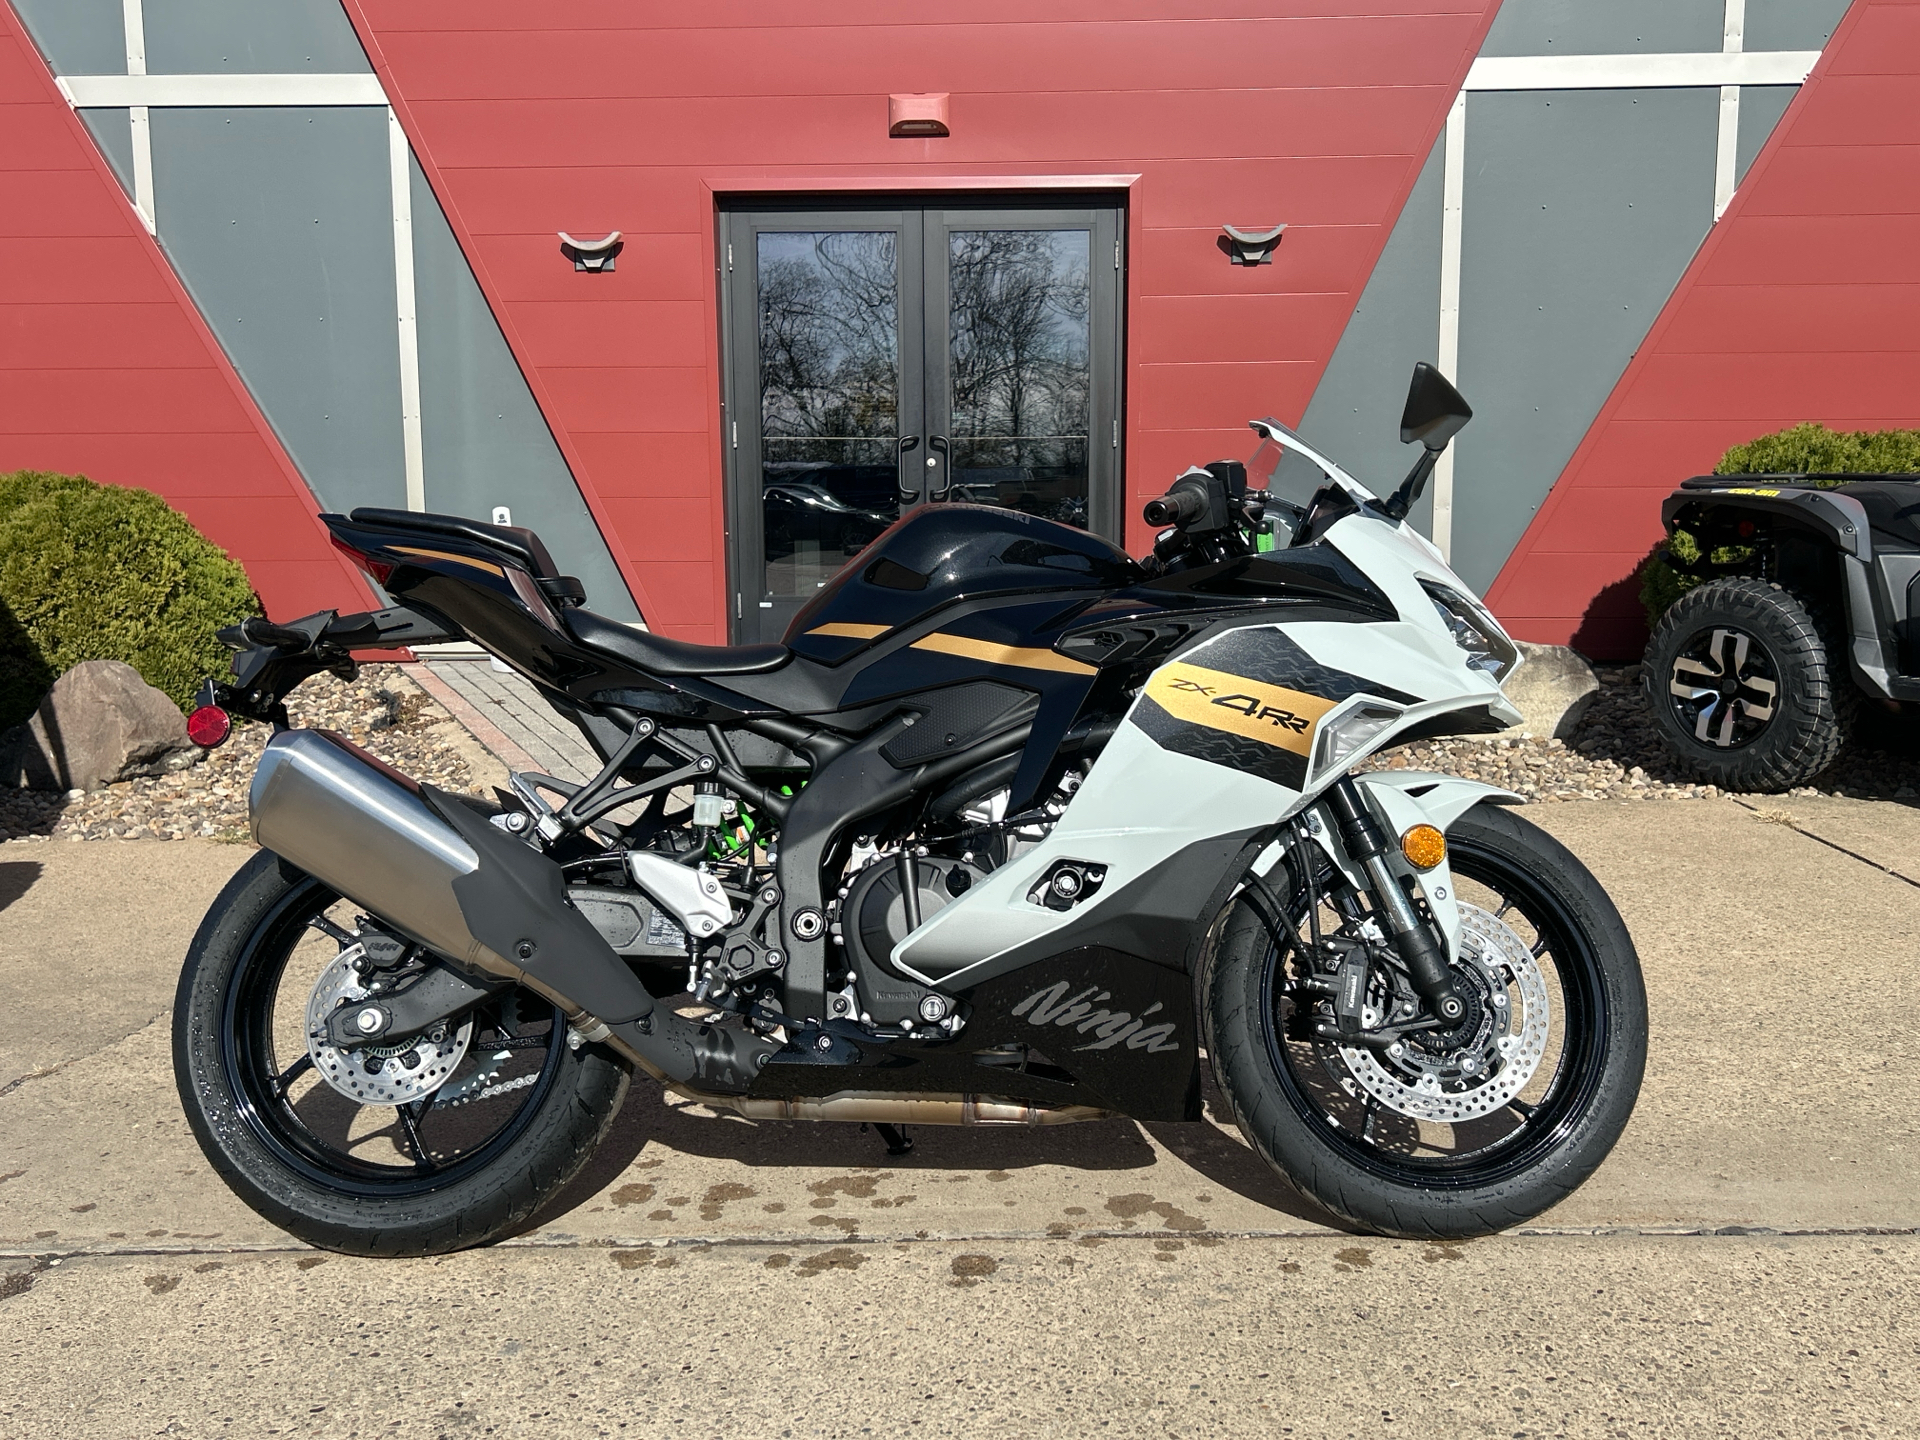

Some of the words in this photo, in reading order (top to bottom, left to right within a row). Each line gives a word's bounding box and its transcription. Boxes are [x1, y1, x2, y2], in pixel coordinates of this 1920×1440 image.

[876, 991, 921, 1000] Kawasaki
[1348, 974, 1358, 1009] Kawasaki
[1011, 981, 1179, 1053] Ninja
